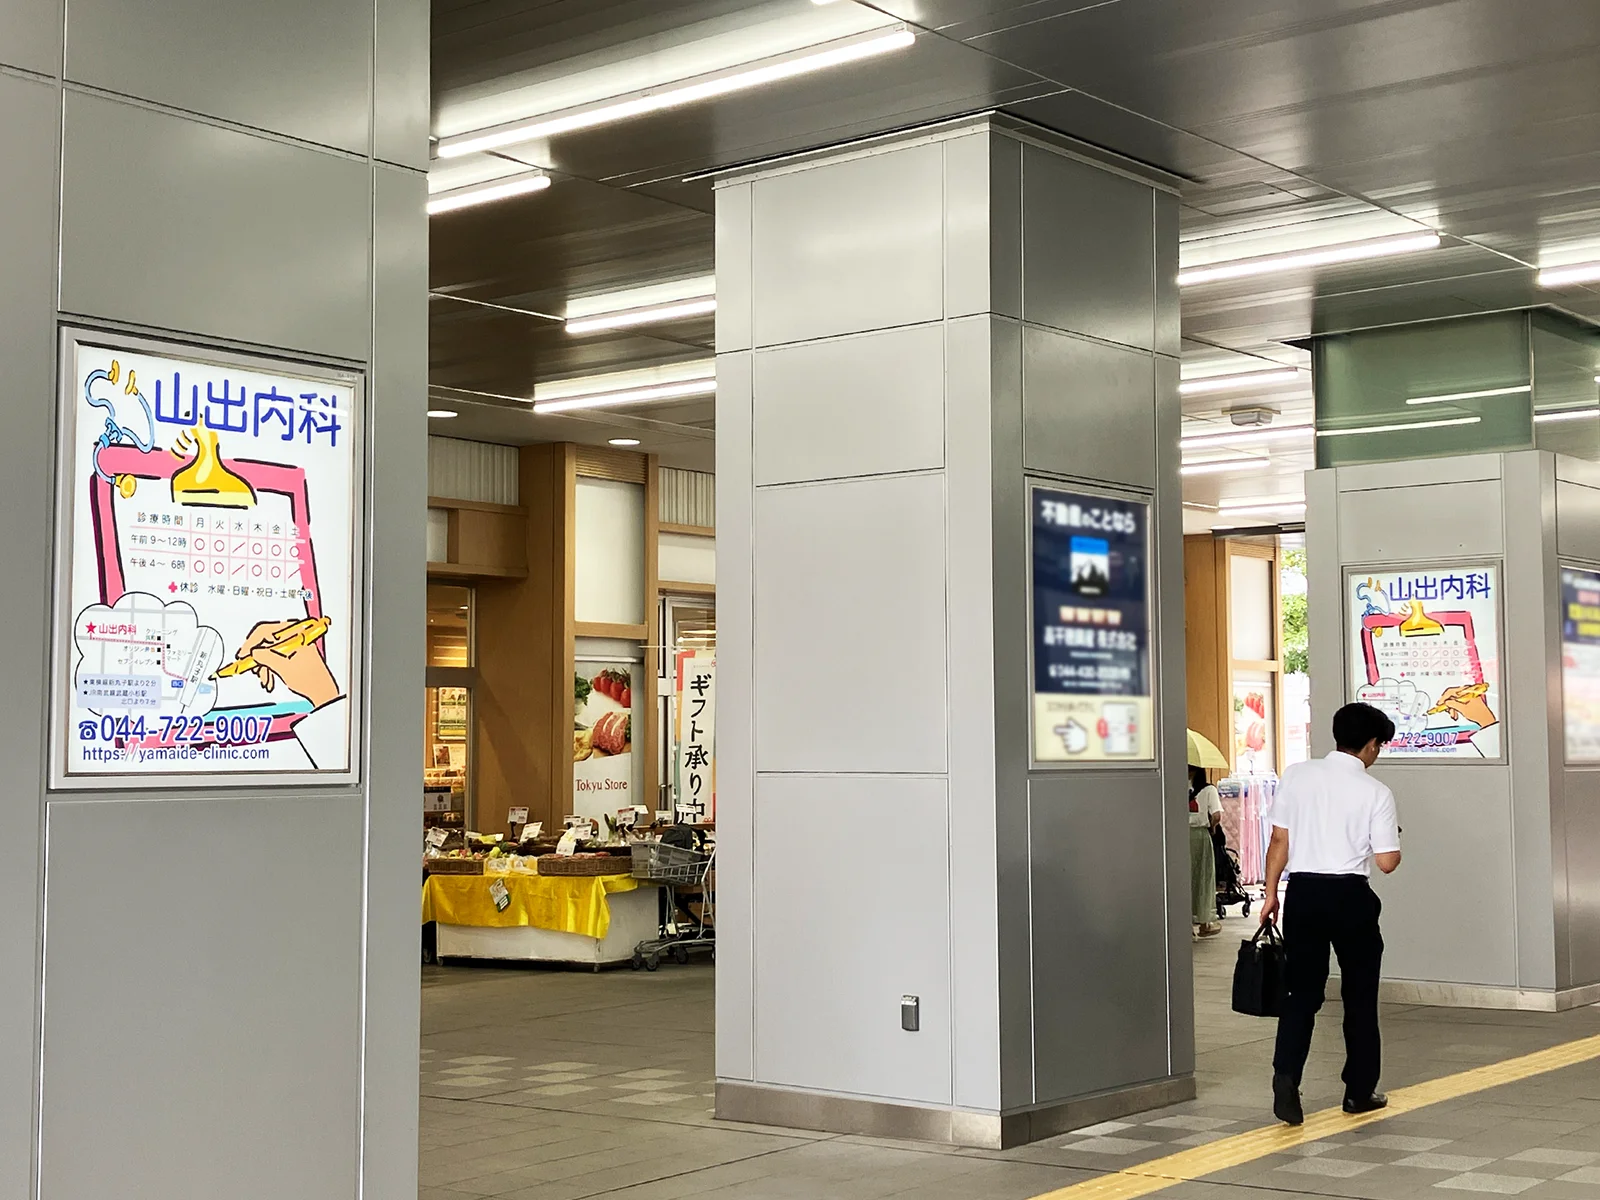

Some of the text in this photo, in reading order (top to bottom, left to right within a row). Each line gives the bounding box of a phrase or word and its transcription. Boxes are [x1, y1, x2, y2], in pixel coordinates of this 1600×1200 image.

[155, 372, 341, 447] 山出内科
[137, 511, 299, 536] 診療時間 月 火 水 木 金 土
[180, 583, 198, 593] 休診
[1390, 572, 1491, 601] 山出内科
[99, 624, 136, 635] 山出内科
[101, 714, 272, 742] 044-722-9007
[1393, 732, 1458, 745] -722-9007
[83, 746, 270, 763] https://yamaide-clinic.com
[685, 674, 712, 823] ギフト承り中
[576, 778, 628, 793] Tokyu Store
